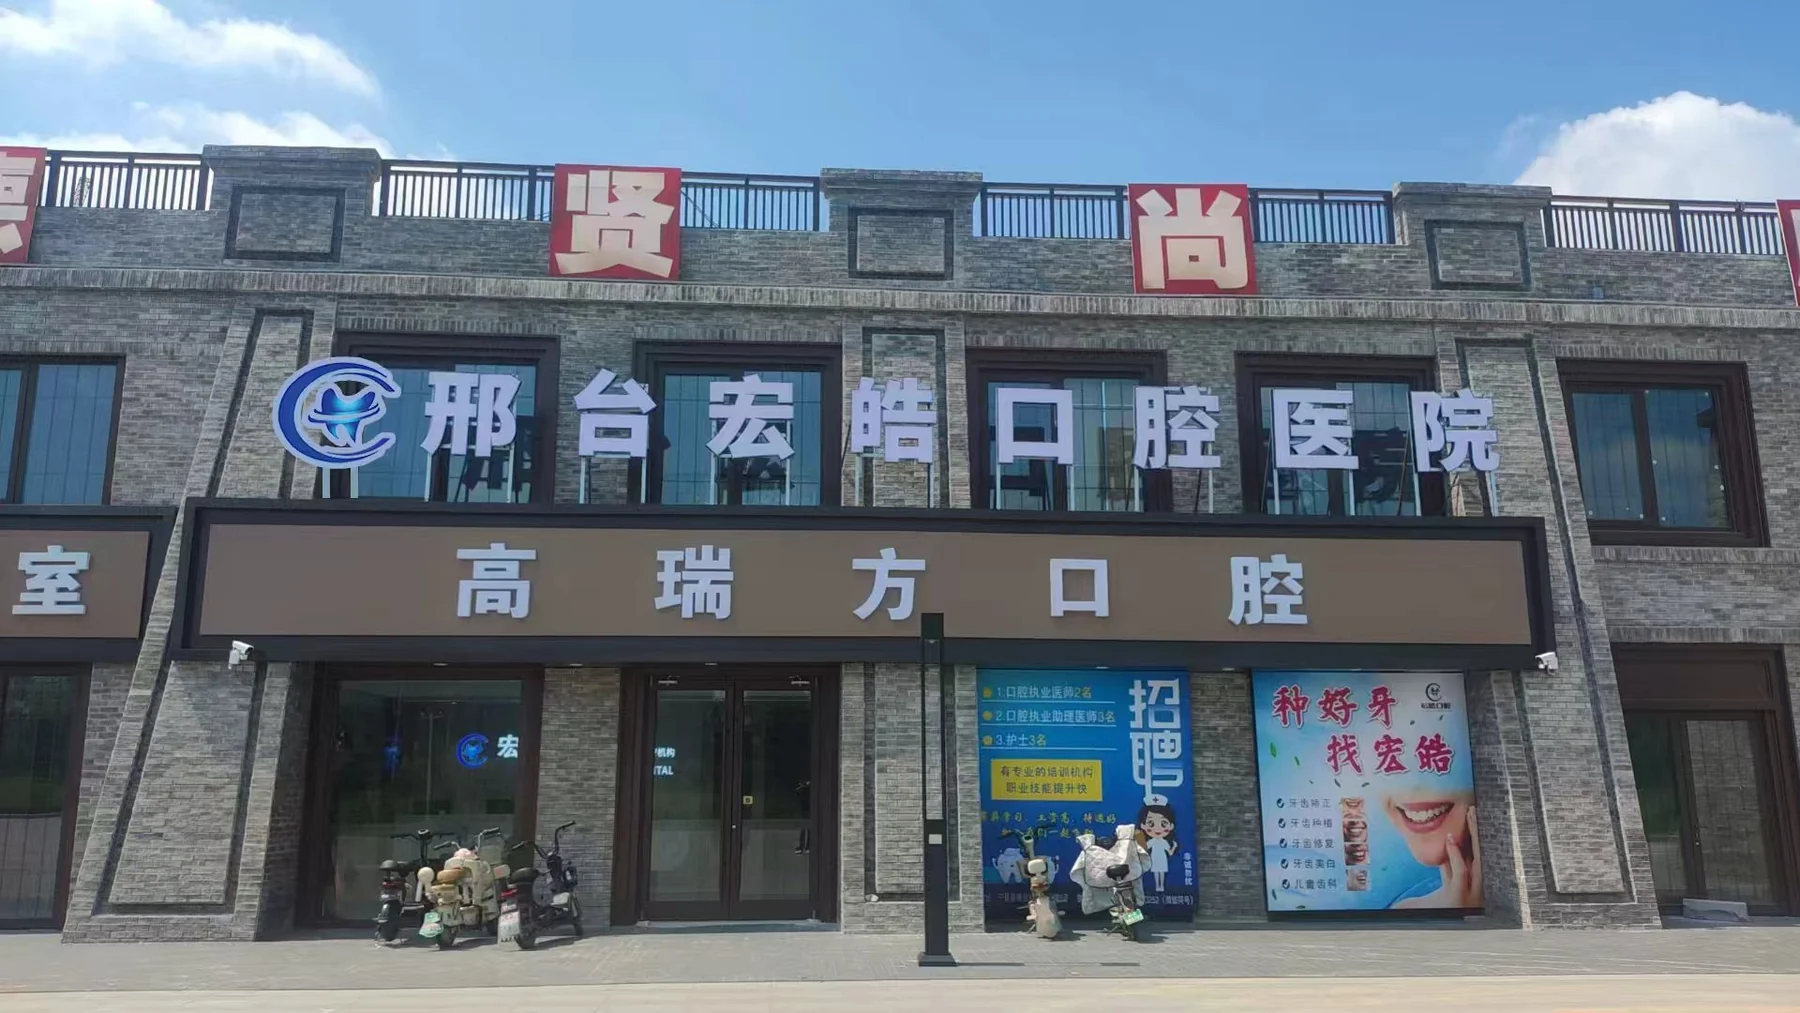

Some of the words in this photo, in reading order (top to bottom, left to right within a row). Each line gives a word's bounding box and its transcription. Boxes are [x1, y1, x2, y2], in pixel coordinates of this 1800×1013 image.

[555, 169, 673, 278] 贤
[1135, 188, 1249, 290] 尚
[420, 368, 1500, 473] 邢台宏皓口腔医院
[12, 545, 91, 615] 室
[455, 542, 1308, 626] 高瑞方口腔
[997, 685, 1092, 699] 1.口腔执业医师2名
[1274, 684, 1397, 728] 种好牙
[996, 734, 1046, 746] 3.护士3名
[1128, 678, 1184, 796] 招聘
[654, 746, 676, 758] 机构
[1326, 732, 1453, 774] 找宏皓
[1000, 765, 1093, 778] 有专业的培训机构
[1006, 781, 1087, 795] 职业技能提升快
[1290, 818, 1333, 829] 牙齿种植
[1291, 838, 1334, 849] 牙齿修复
[1293, 858, 1336, 869] 牙齿美白
[1294, 878, 1337, 890] 儿童齿科
